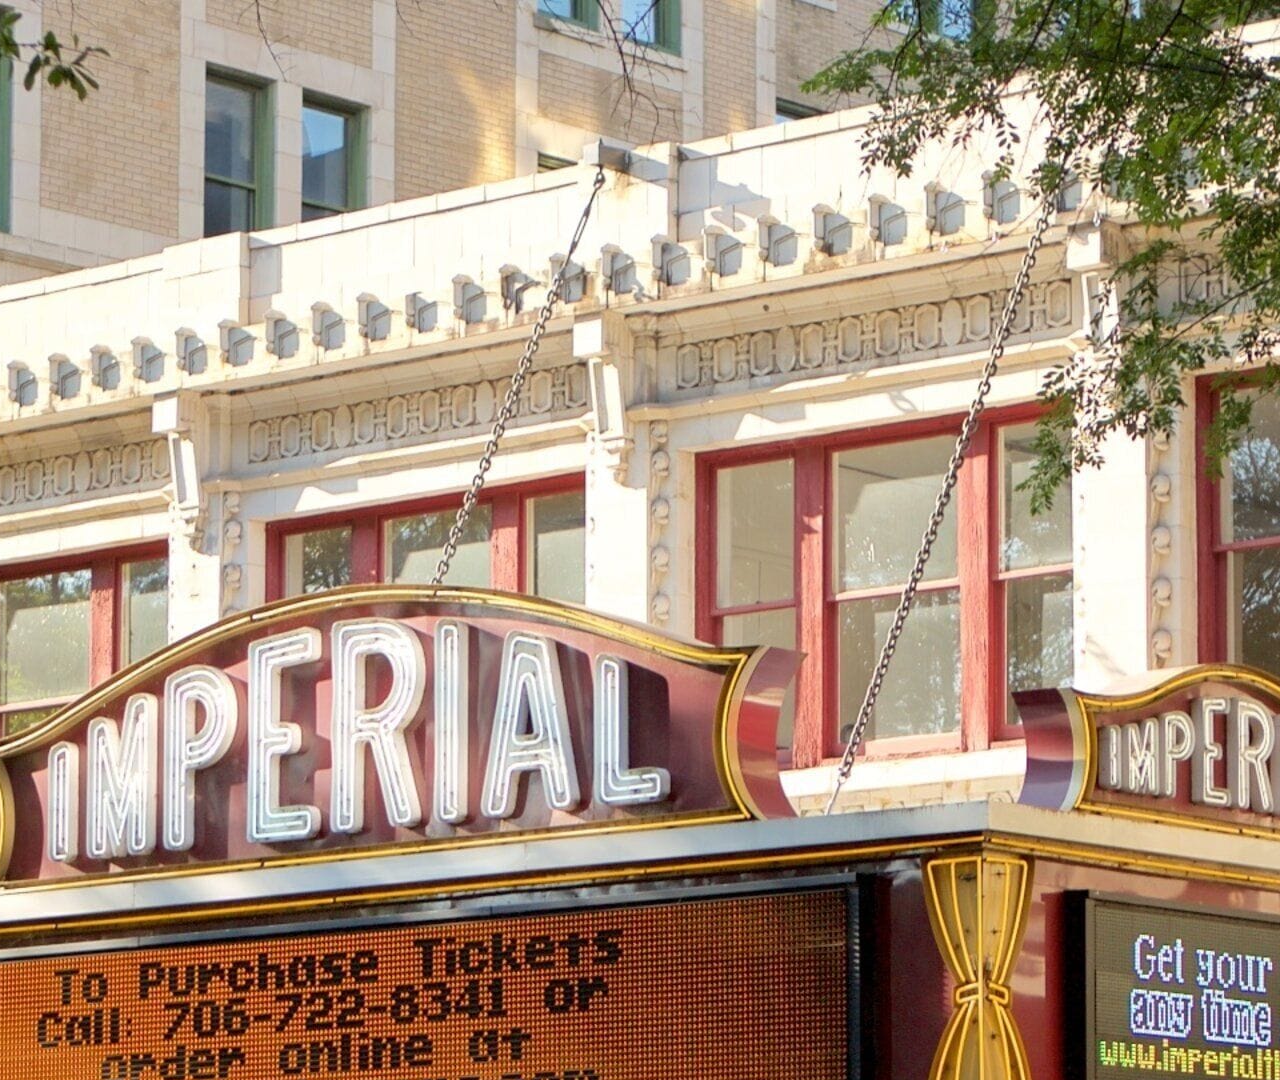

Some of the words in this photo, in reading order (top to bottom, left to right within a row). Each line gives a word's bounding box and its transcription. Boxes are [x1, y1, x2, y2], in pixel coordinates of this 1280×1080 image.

[47, 617, 671, 864] IMPERIAL
[54, 967, 109, 1006] To
[139, 949, 378, 999] Purchase
[414, 928, 623, 979] Tickets
[1132, 933, 1186, 984] Get
[1195, 948, 1273, 994] your
[163, 977, 508, 1041] 706-722-8341
[543, 975, 610, 1015] or
[1201, 987, 1272, 1046] time
[279, 1031, 434, 1076] online
[469, 1026, 533, 1065] at
